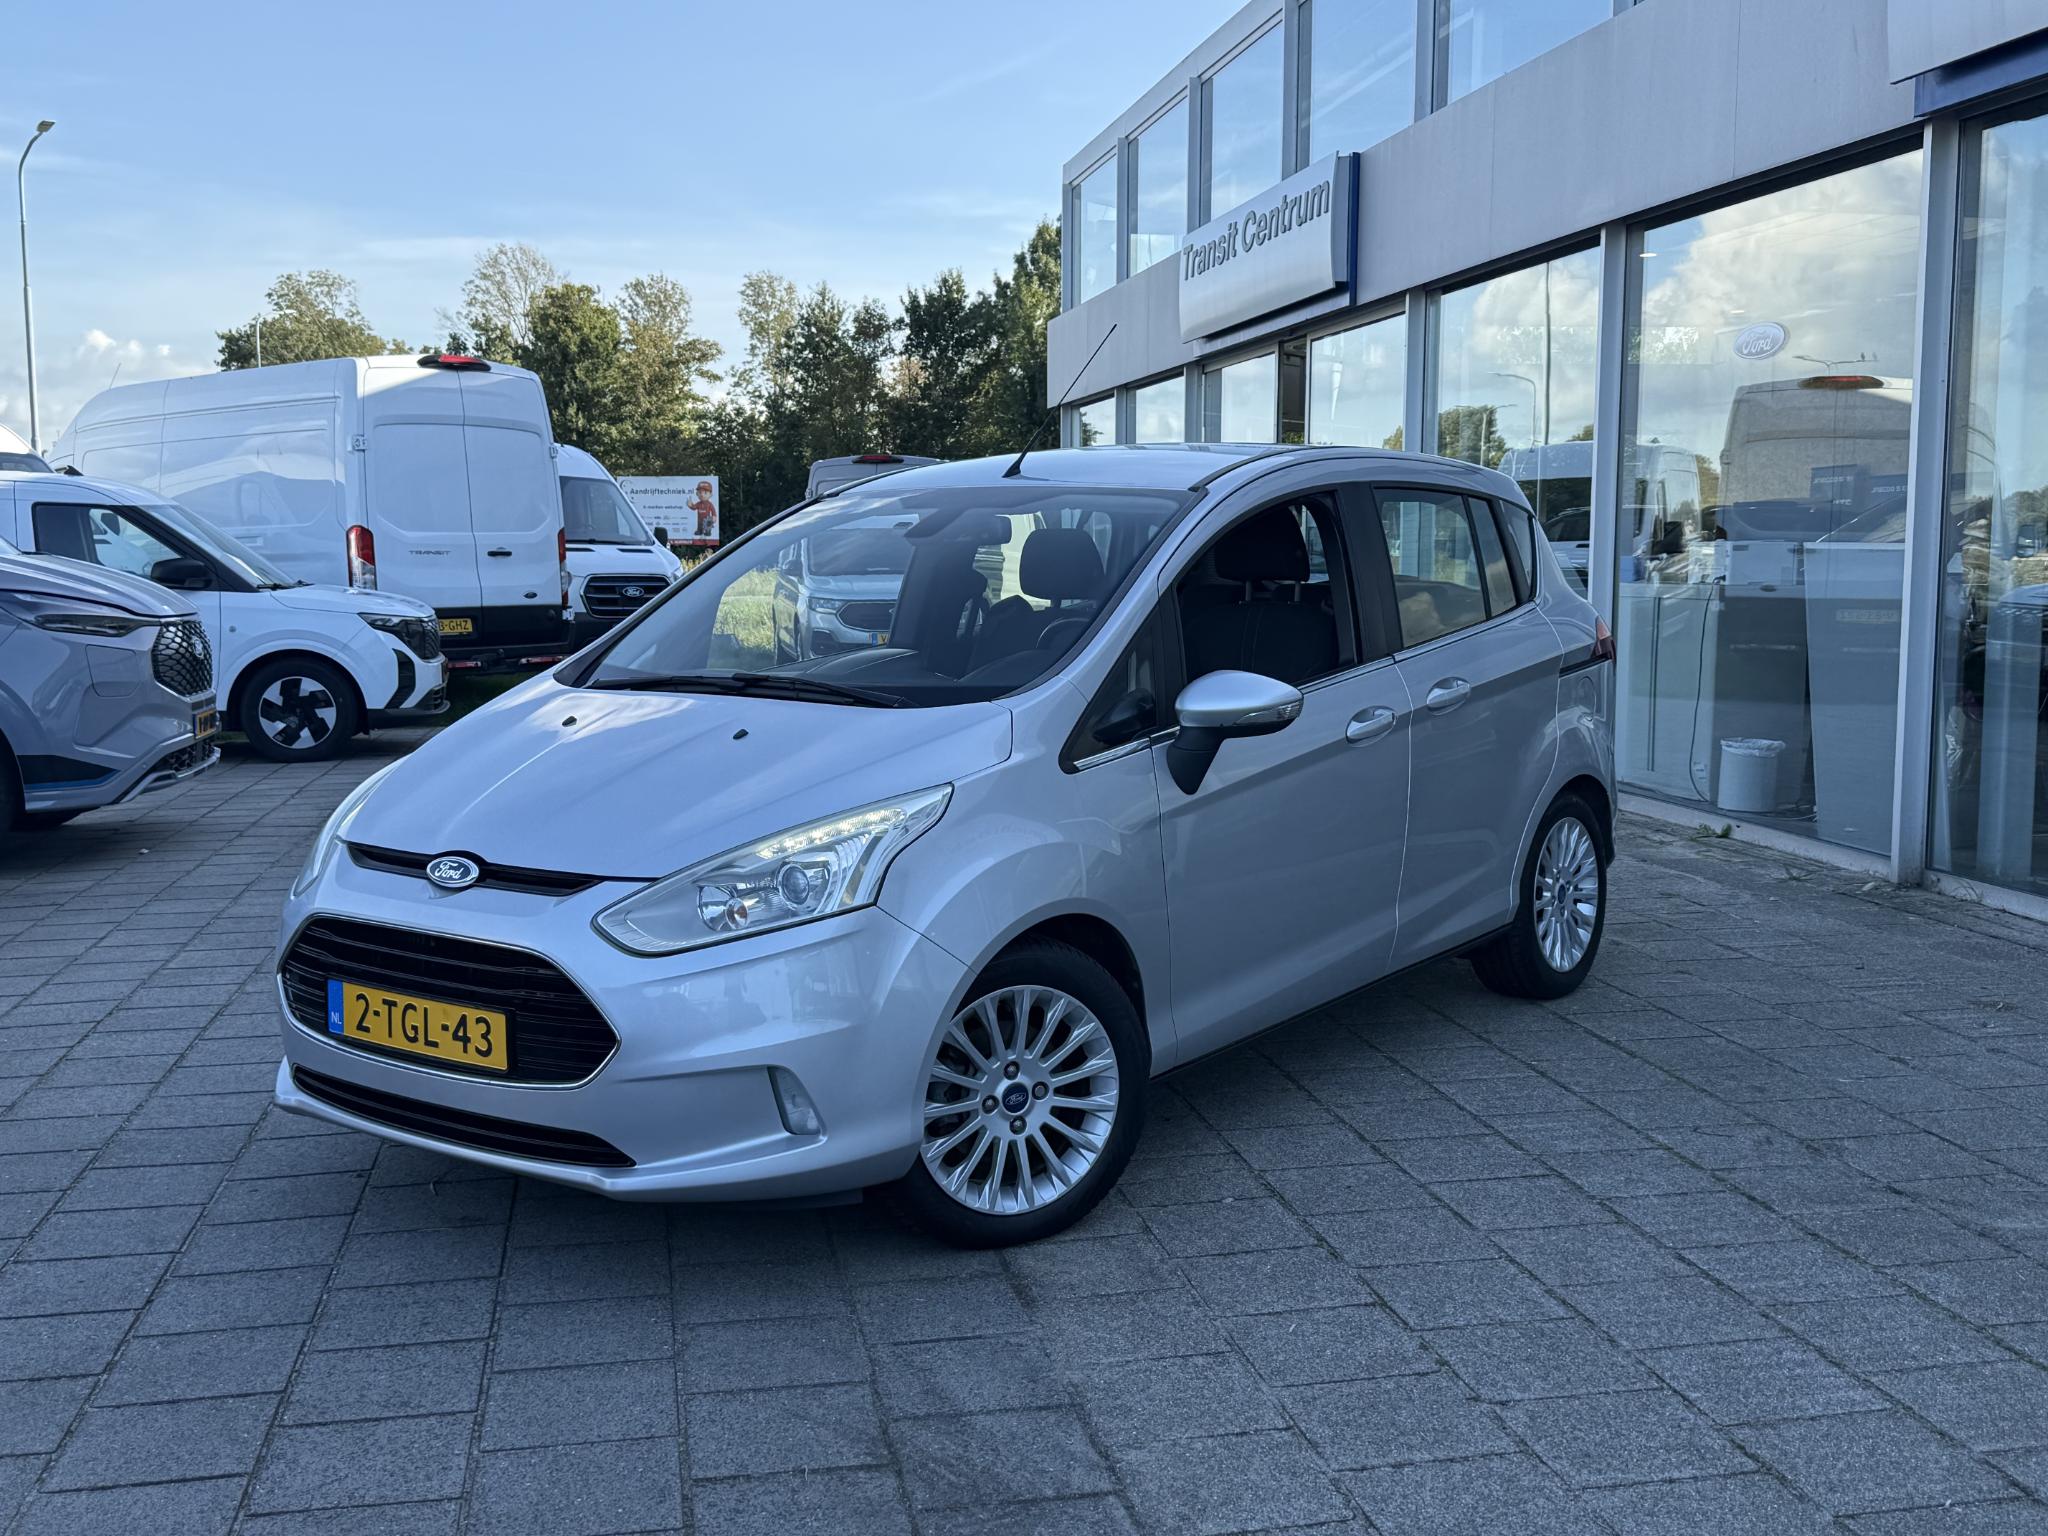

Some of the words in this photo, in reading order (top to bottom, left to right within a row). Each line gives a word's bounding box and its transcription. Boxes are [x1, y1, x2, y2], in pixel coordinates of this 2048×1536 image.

[1183, 221, 1238, 281] Transit
[1242, 180, 1330, 253] Centrum
[630, 487, 694, 496] Aandrijftechniek.nl
[434, 860, 465, 879] Ford
[331, 1011, 342, 1024] NL
[356, 992, 493, 1058] 2-TGL-43
